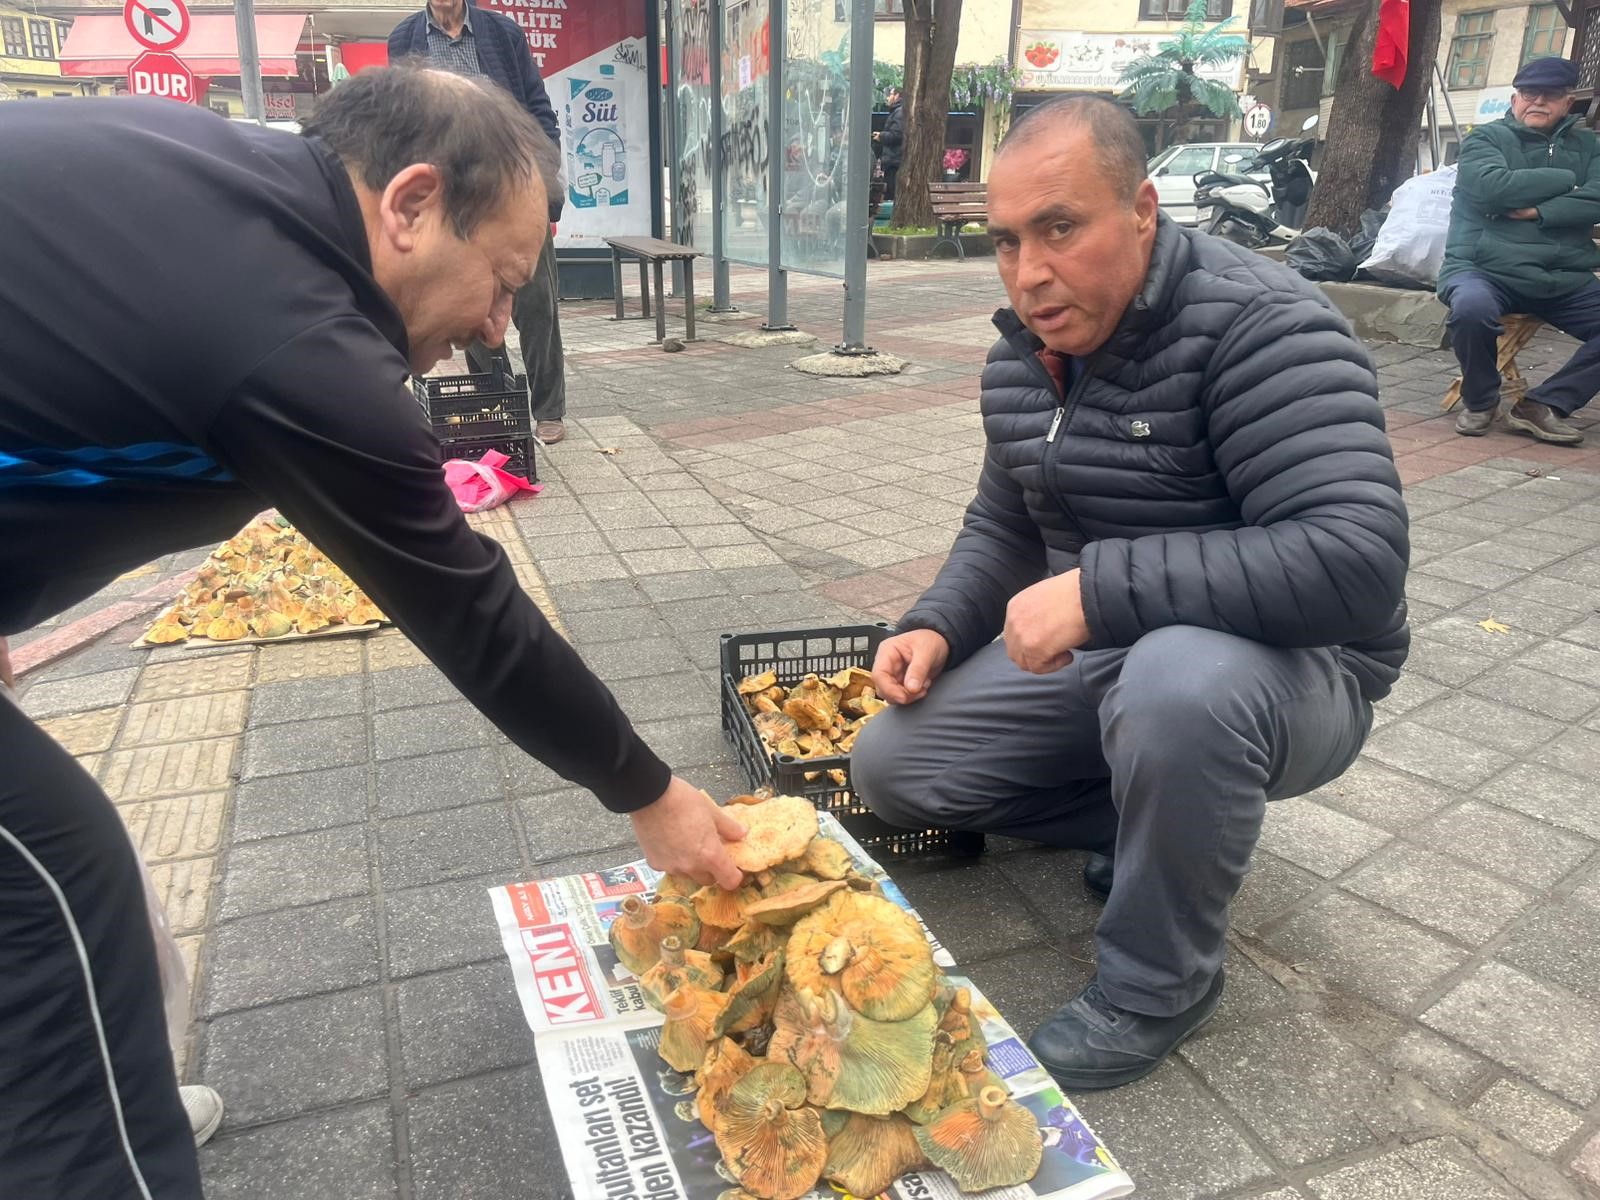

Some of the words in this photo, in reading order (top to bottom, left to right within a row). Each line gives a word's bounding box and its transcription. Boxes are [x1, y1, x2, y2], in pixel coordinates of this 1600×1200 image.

[496, 9, 562, 29] ALİTE
[525, 29, 558, 48] ÜK
[134, 71, 188, 98] DUR
[582, 102, 619, 123] Süt
[521, 928, 598, 1024] KENT
[609, 989, 631, 1014] Teklif
[624, 985, 647, 1011] kabul
[568, 1075, 606, 1107] set
[604, 1075, 663, 1161] kazandı!
